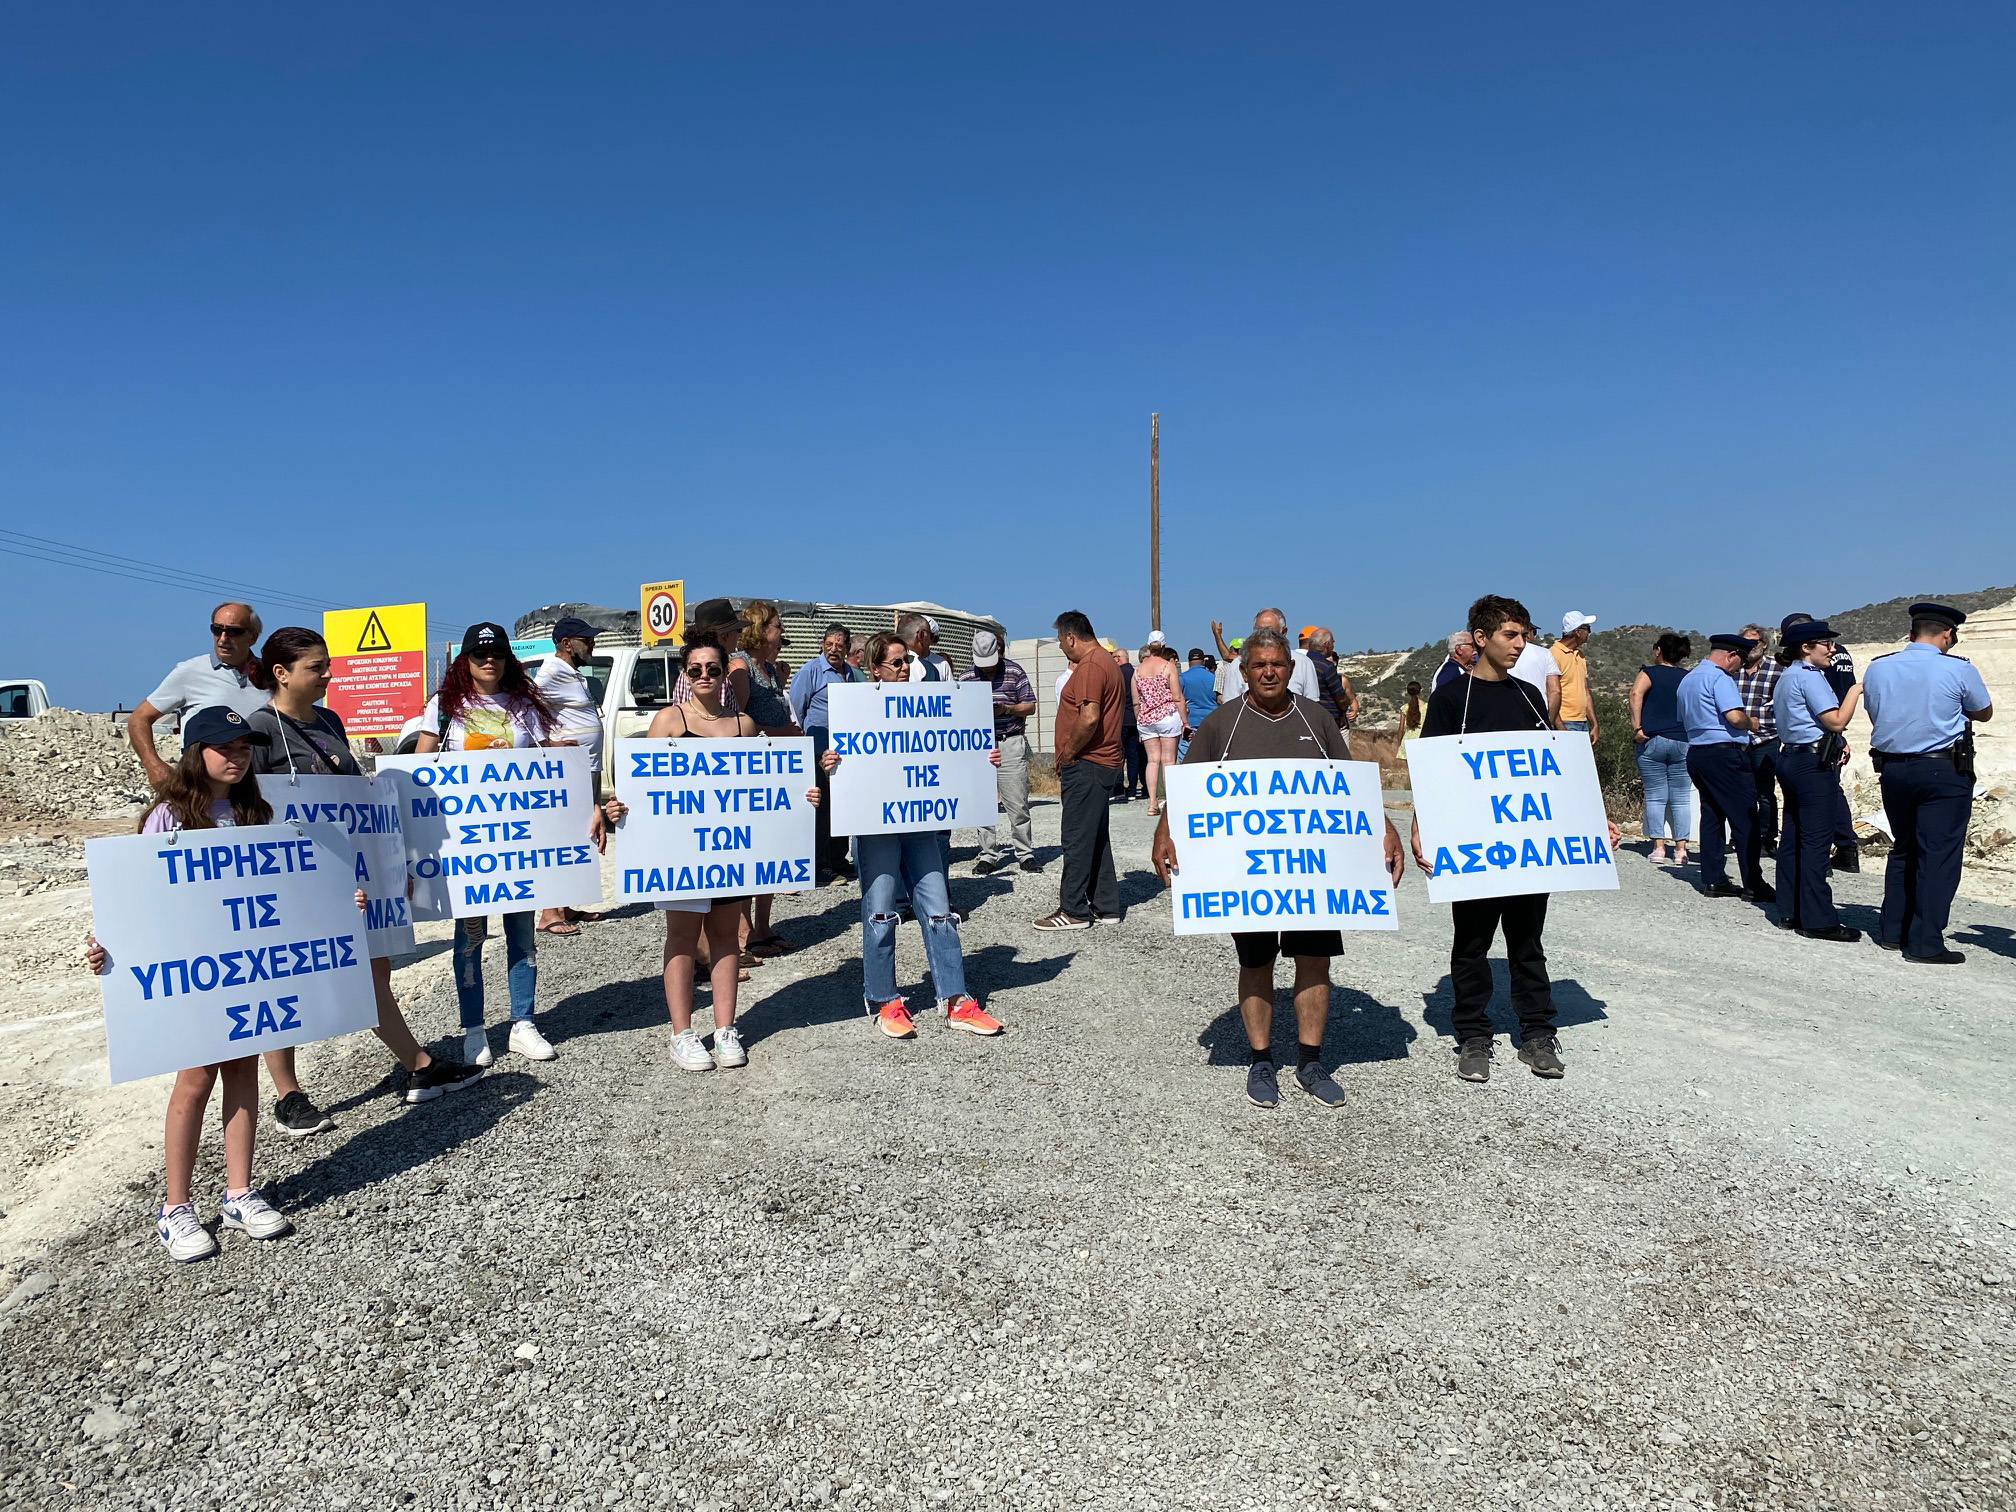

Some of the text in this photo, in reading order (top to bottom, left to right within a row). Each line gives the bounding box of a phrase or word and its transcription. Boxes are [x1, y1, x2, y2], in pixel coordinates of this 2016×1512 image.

[652, 603, 672, 626] 30
[366, 682, 389, 690] ΕΧΟΝΤΕΣ
[885, 695, 952, 718] ΓΙΝΑΜΕ
[832, 728, 992, 755] ΣΚΟΥΠΙΔΟΤΟΠΟΣ
[412, 760, 564, 787] ΟΧΙ ΑΛΛΗ
[631, 750, 803, 777] ΣΕΒΑΣΤΕΙΤΕ
[903, 765, 939, 788] ΤΗΣ
[1460, 748, 1562, 779] ΥΓΕΙΑ
[1206, 770, 1350, 798] ΟΧΙ ΑΛΛΑ
[411, 789, 568, 818] ΜΟΛΥΝΣΗ
[646, 787, 791, 815] ΤΗΝ ΥΓΕΙΑ
[883, 798, 959, 824] ΚΥΠΡΟΥ
[1490, 792, 1552, 824] ΚΑΙ
[459, 821, 531, 844] ΣΤΙΣ
[1188, 809, 1372, 838] ΕΡΓΟΣΤΑΣΙΑ
[694, 826, 751, 851] ΤΩΝ
[158, 840, 317, 884] ΤΗΡΗΣΤΕ
[1246, 848, 1327, 875] ΣΤΗΝ
[1433, 836, 1611, 877] ΑΣΦΑΛΕΙΑ
[624, 858, 810, 894] ΠΑΙΔΙΩΝ ΜΑΣ
[465, 880, 534, 905] ΜΑΣ
[1182, 888, 1389, 918] ΠΕΡΙΟΧΗ ΜΑΣ
[222, 894, 281, 932] ΤΙΣ
[366, 897, 407, 930] ΜΑΣ
[130, 935, 358, 1001] ΥΠΟΣΧΕΣΕΙΣ
[225, 995, 302, 1041] ΣΑΣ
